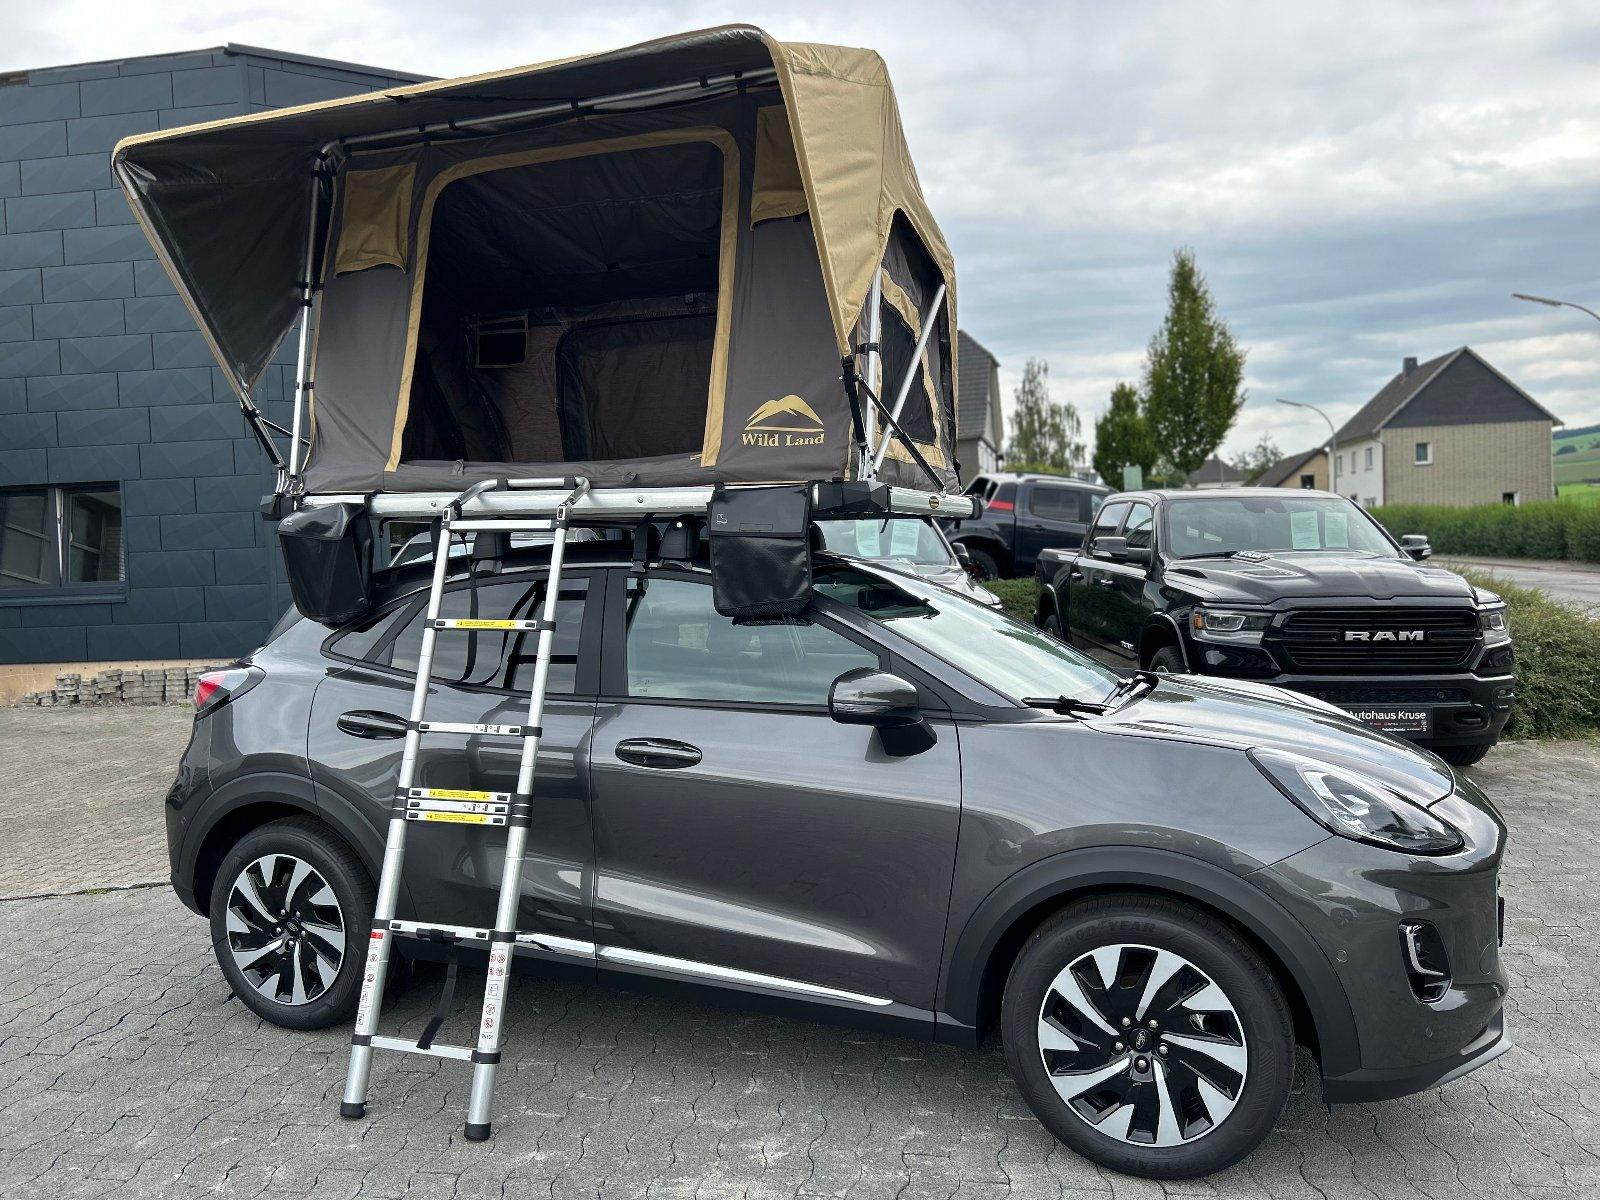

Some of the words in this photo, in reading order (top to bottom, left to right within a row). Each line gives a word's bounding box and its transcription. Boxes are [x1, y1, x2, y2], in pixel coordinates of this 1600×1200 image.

[741, 433, 779, 447] Wild
[784, 433, 824, 447] Land
[1344, 630, 1424, 641] RAM
[1398, 710, 1426, 719] Kruse
